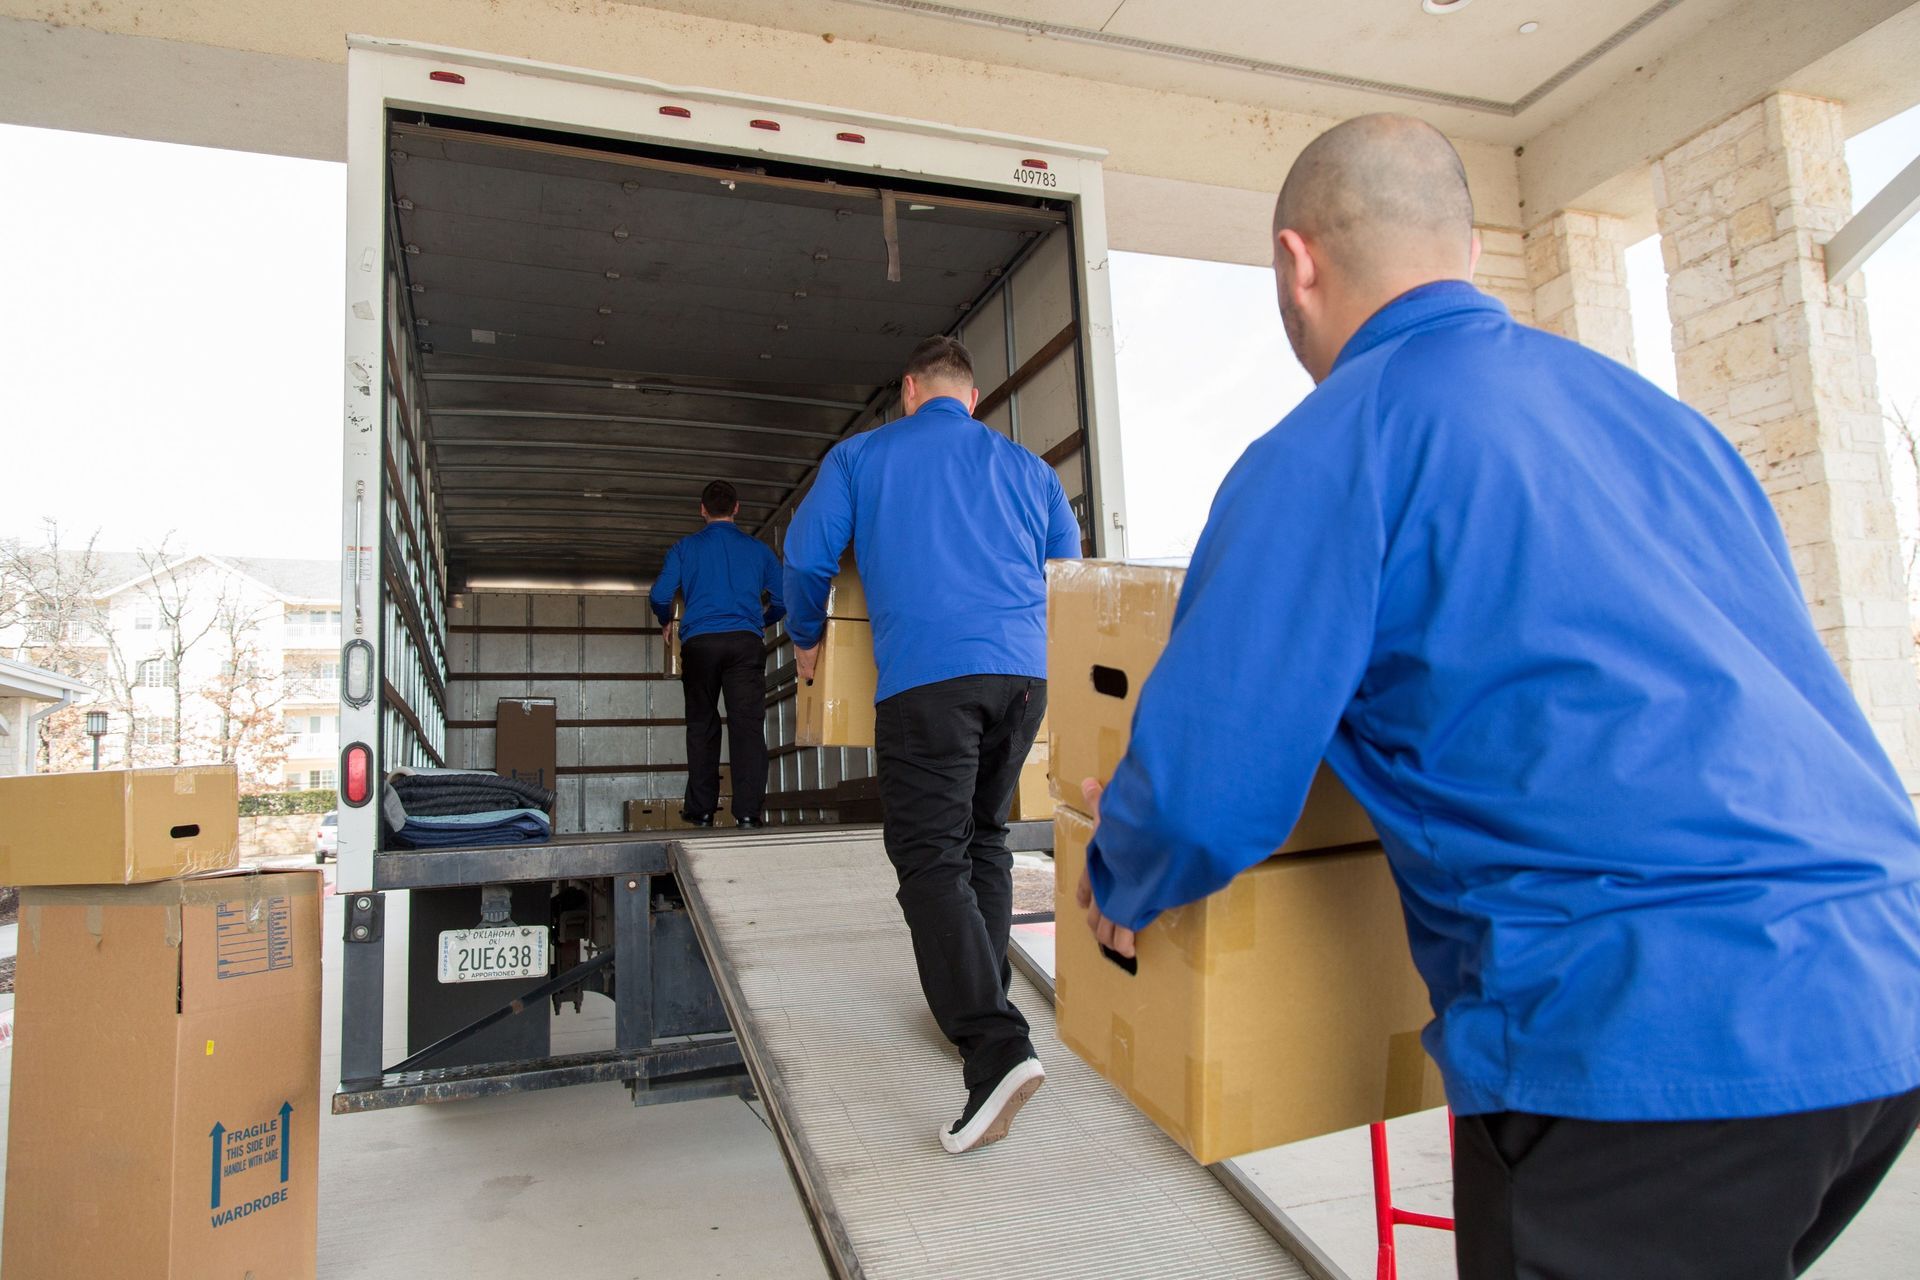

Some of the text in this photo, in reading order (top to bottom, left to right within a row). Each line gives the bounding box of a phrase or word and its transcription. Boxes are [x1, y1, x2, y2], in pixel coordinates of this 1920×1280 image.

[1013, 168, 1057, 187] 409783
[473, 929, 516, 939] OKLAHOMA
[458, 945, 531, 972] 2UE638
[471, 970, 516, 978] APPORTIONED
[227, 1119, 278, 1145] FRAGILE
[226, 1134, 277, 1161] THIS SIDE UP
[223, 1148, 279, 1177] HANDLE WITH CARE
[211, 1187, 289, 1228] WARDROBE
